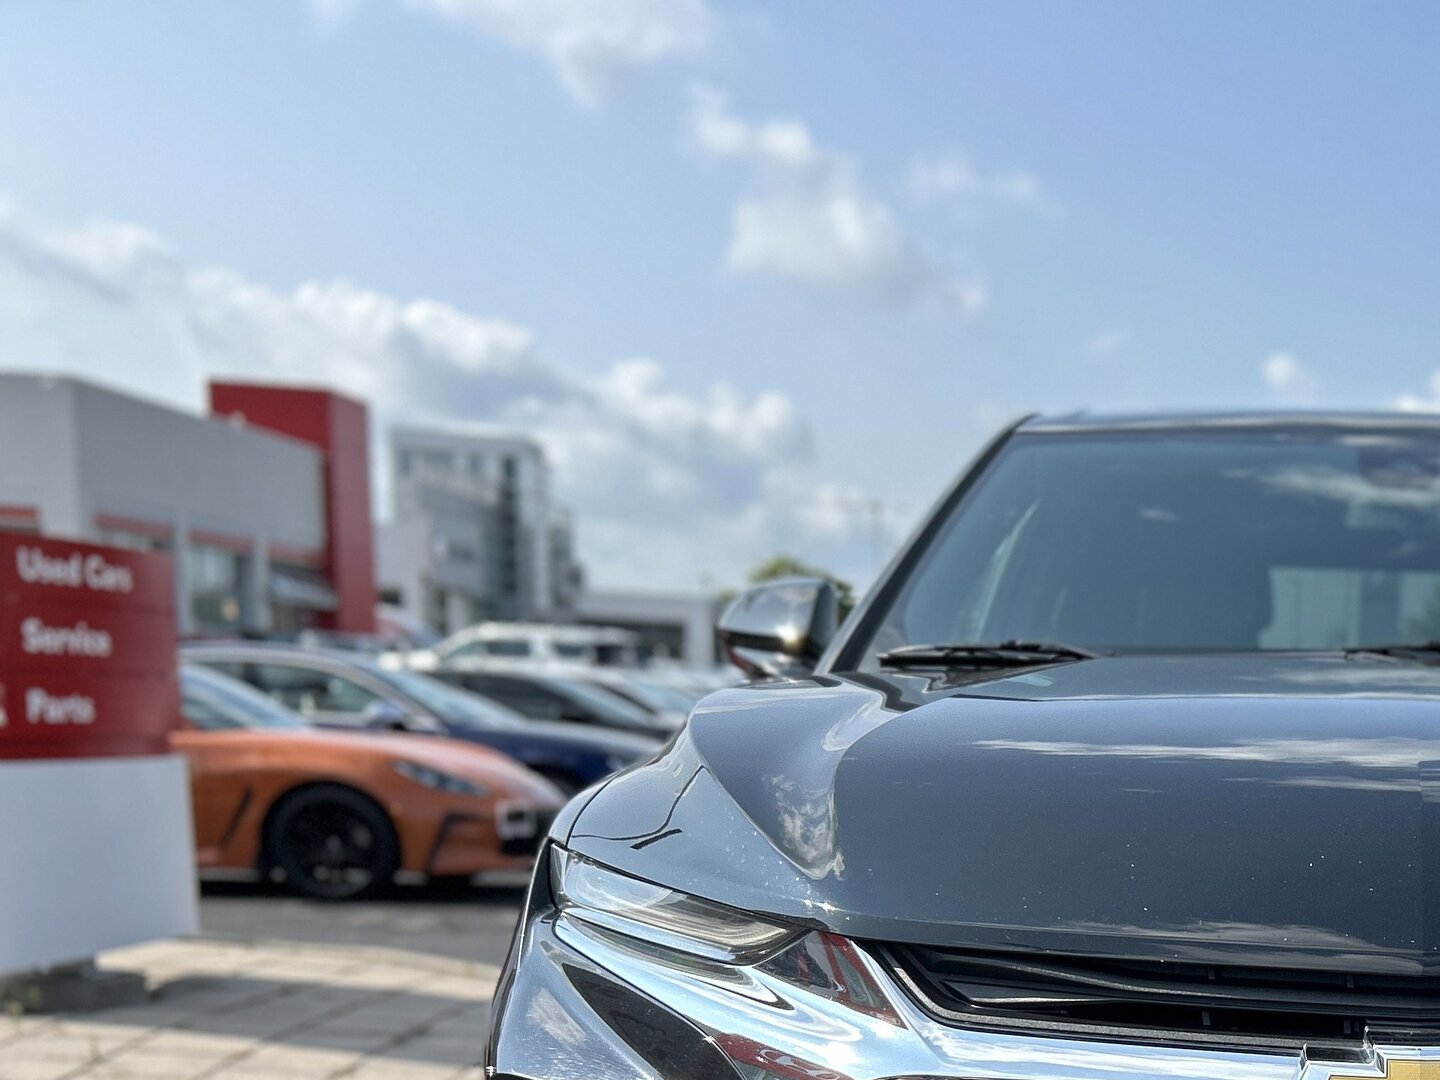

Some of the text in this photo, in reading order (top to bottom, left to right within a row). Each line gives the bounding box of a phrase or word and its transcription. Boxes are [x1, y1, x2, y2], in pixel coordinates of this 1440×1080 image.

[17, 547, 133, 592] Used Cars
[21, 617, 111, 657] Service
[26, 687, 95, 724] Parts
